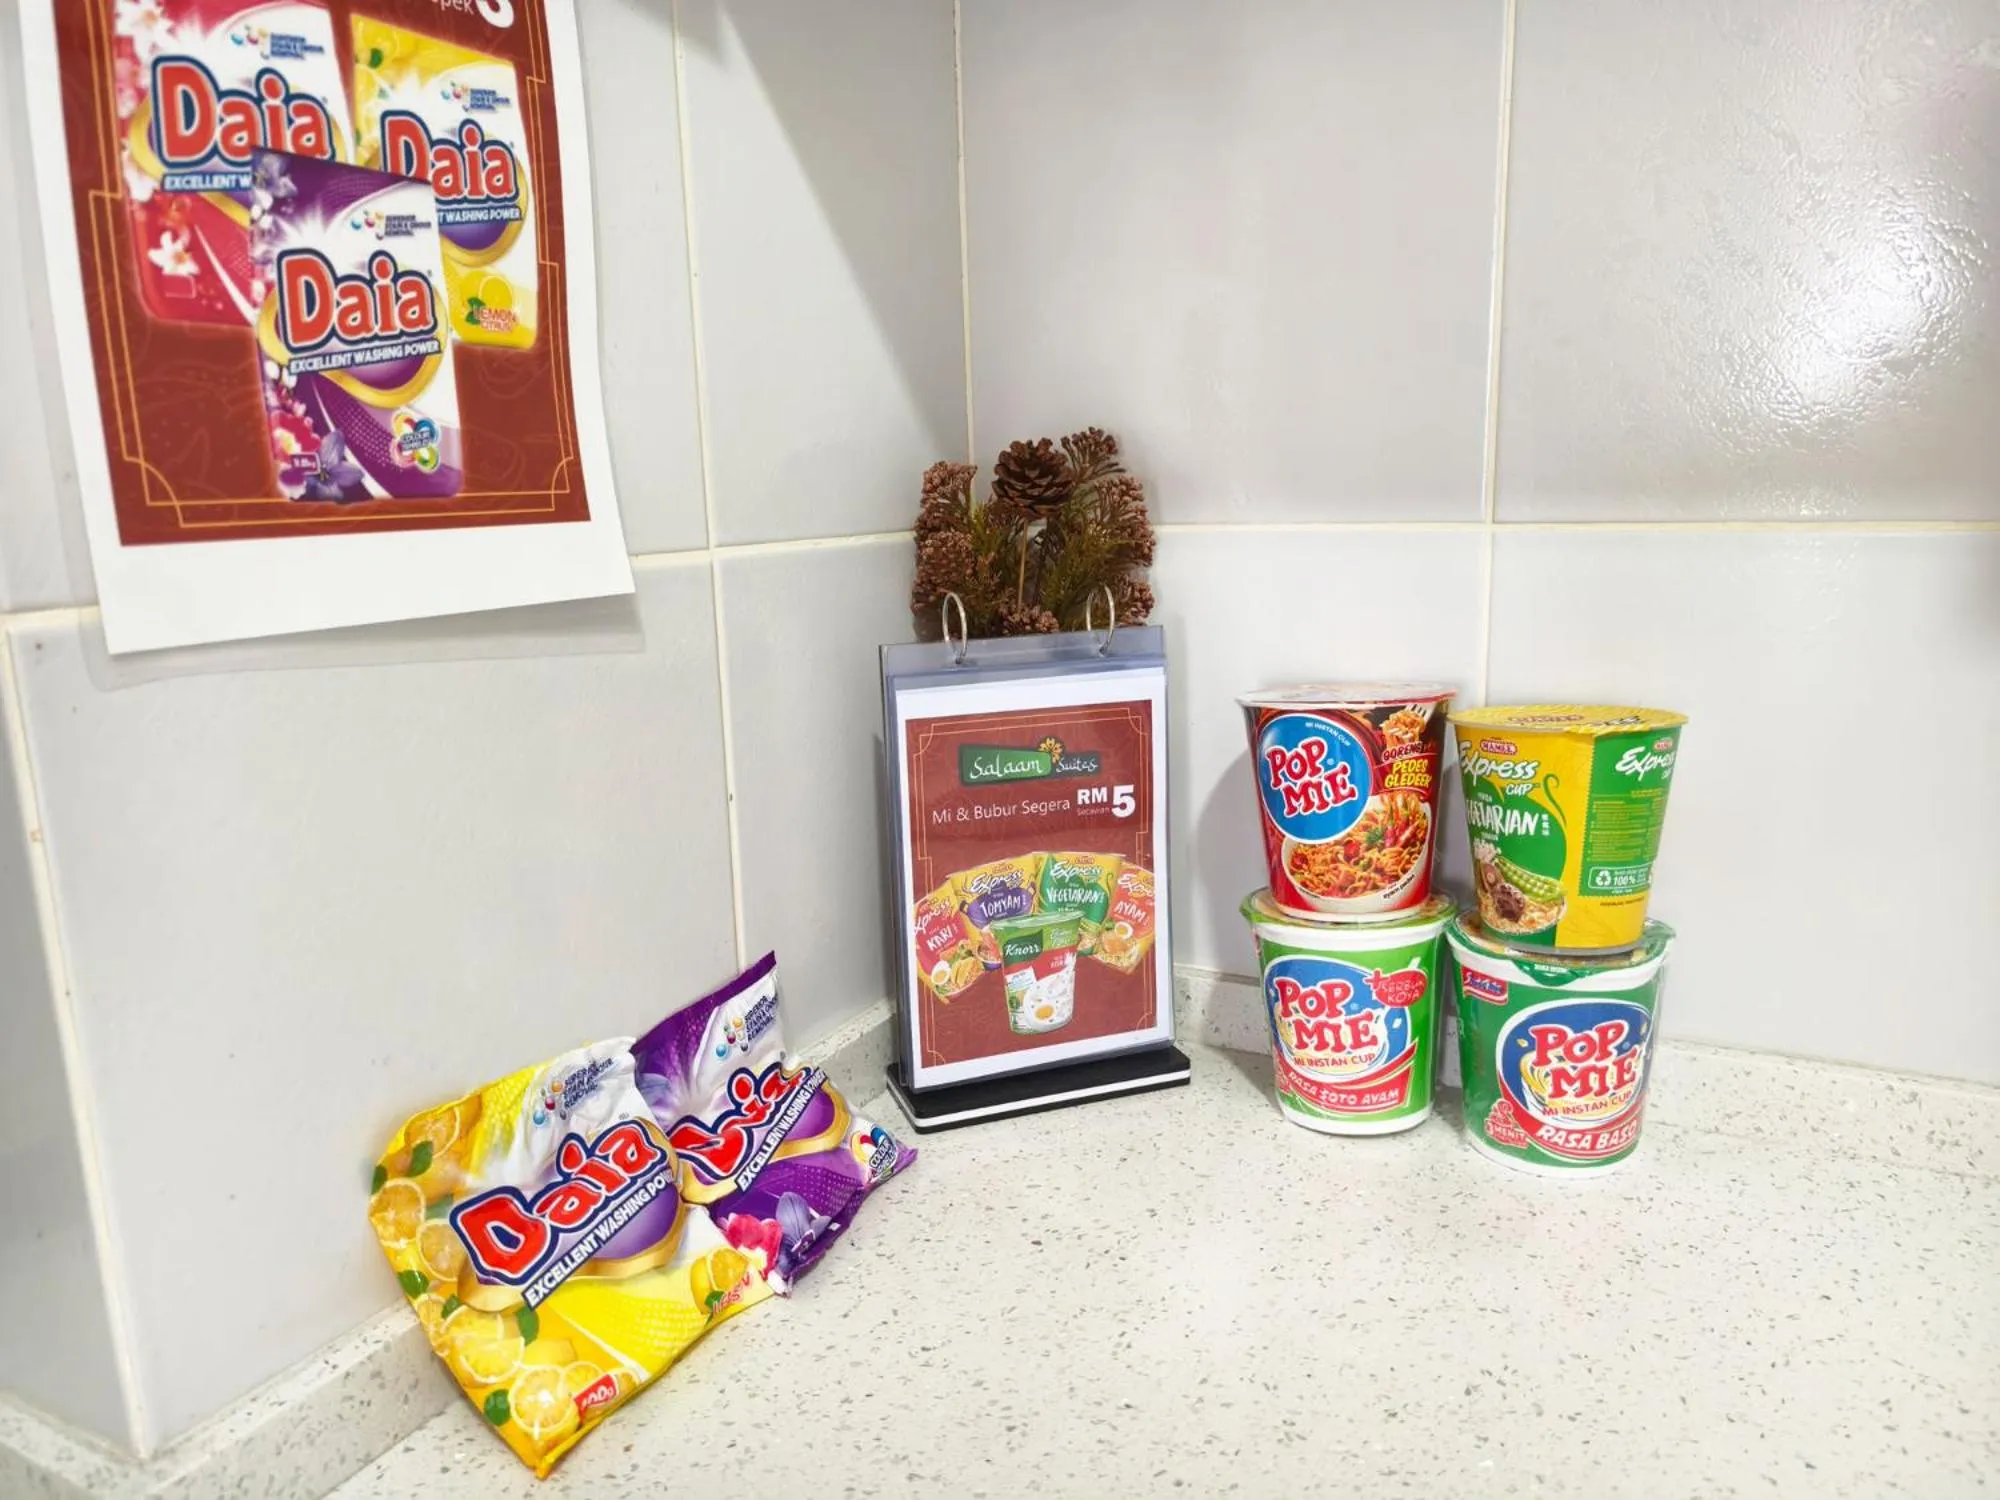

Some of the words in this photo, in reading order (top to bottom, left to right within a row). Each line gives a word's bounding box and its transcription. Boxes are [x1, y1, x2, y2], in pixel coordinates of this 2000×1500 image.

[154, 58, 335, 166] Daia
[382, 113, 517, 202] Daia
[164, 174, 237, 191] EXCELLENT
[446, 208, 489, 222] WASHING
[490, 207, 520, 220] POWER
[280, 253, 435, 348] Daia
[289, 353, 352, 374] EXCELLENT
[354, 347, 403, 367] WASHING
[404, 341, 440, 357] POWER
[969, 755, 1044, 780] Salaam
[1056, 756, 1099, 773] Suites
[1266, 738, 1327, 788] POP
[1392, 759, 1429, 774] PEDES
[1077, 786, 1108, 805] RM
[1111, 784, 1136, 818] 5
[1282, 765, 1358, 817] MIE
[1505, 783, 1534, 796] CUP
[932, 809, 951, 825] Mi
[956, 807, 970, 821] &
[974, 803, 1017, 820] Bubur
[1021, 799, 1070, 815] Segera
[1050, 860, 1103, 882] Express
[980, 895, 1022, 918] TOMYAM
[1046, 887, 1101, 904] VEGETARIAN
[1114, 901, 1148, 923] AYAM
[913, 900, 951, 936] xpress
[926, 925, 954, 952] KARI
[1005, 942, 1041, 957] Knorr
[1274, 977, 1354, 1019] POP
[1292, 1010, 1379, 1053] MIE
[1529, 1020, 1627, 1067] POP
[1306, 1057, 1348, 1069] INSTAN
[1350, 1053, 1377, 1066] CUP
[1547, 1046, 1640, 1099] MIE
[1288, 1071, 1318, 1097] RASA
[1320, 1087, 1357, 1105] SOTO
[1361, 1087, 1400, 1105] AYAM
[1543, 1105, 1559, 1116] MI
[1562, 1101, 1608, 1115] INSTAN
[1612, 1091, 1633, 1108] CUP
[1535, 1124, 1591, 1150] RASA
[737, 1125, 785, 1192] EXCELLENT
[453, 1123, 665, 1282] Daia
[523, 1235, 600, 1308] EXCELLENT
[594, 1186, 651, 1244] WASHING
